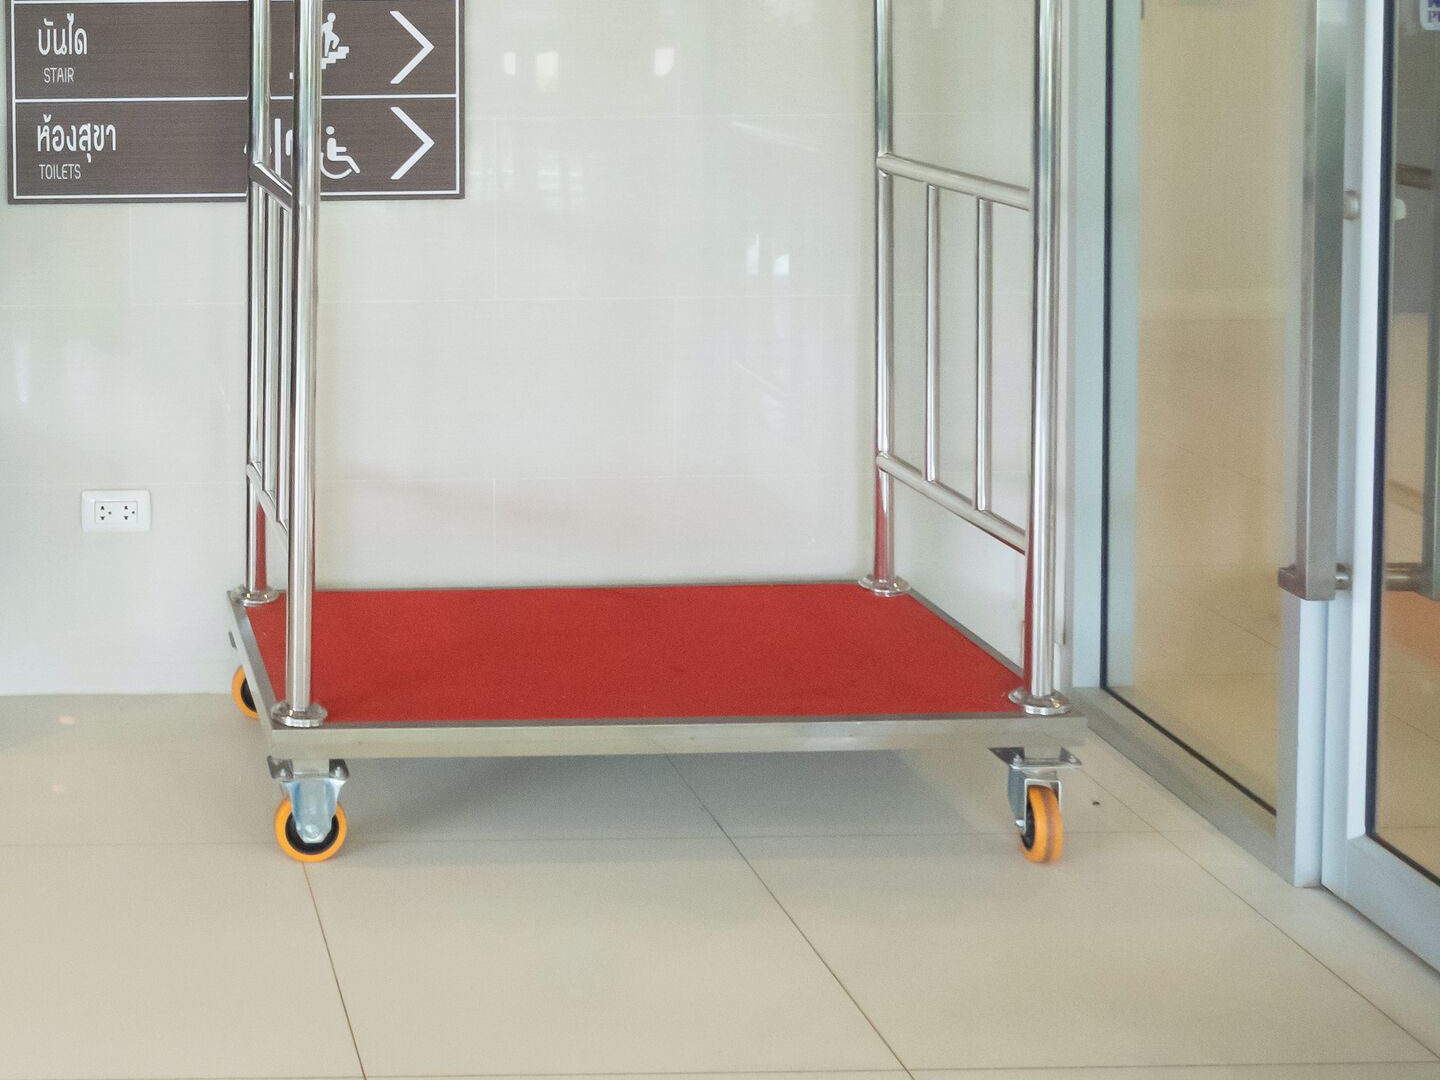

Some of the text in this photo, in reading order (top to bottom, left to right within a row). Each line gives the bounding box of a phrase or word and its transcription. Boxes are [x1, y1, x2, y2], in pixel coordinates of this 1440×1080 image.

[38, 12, 88, 56] บันได
[43, 67, 75, 84] STAIR
[37, 113, 117, 163] ห้องสุขา
[39, 163, 81, 180] TOILETS
